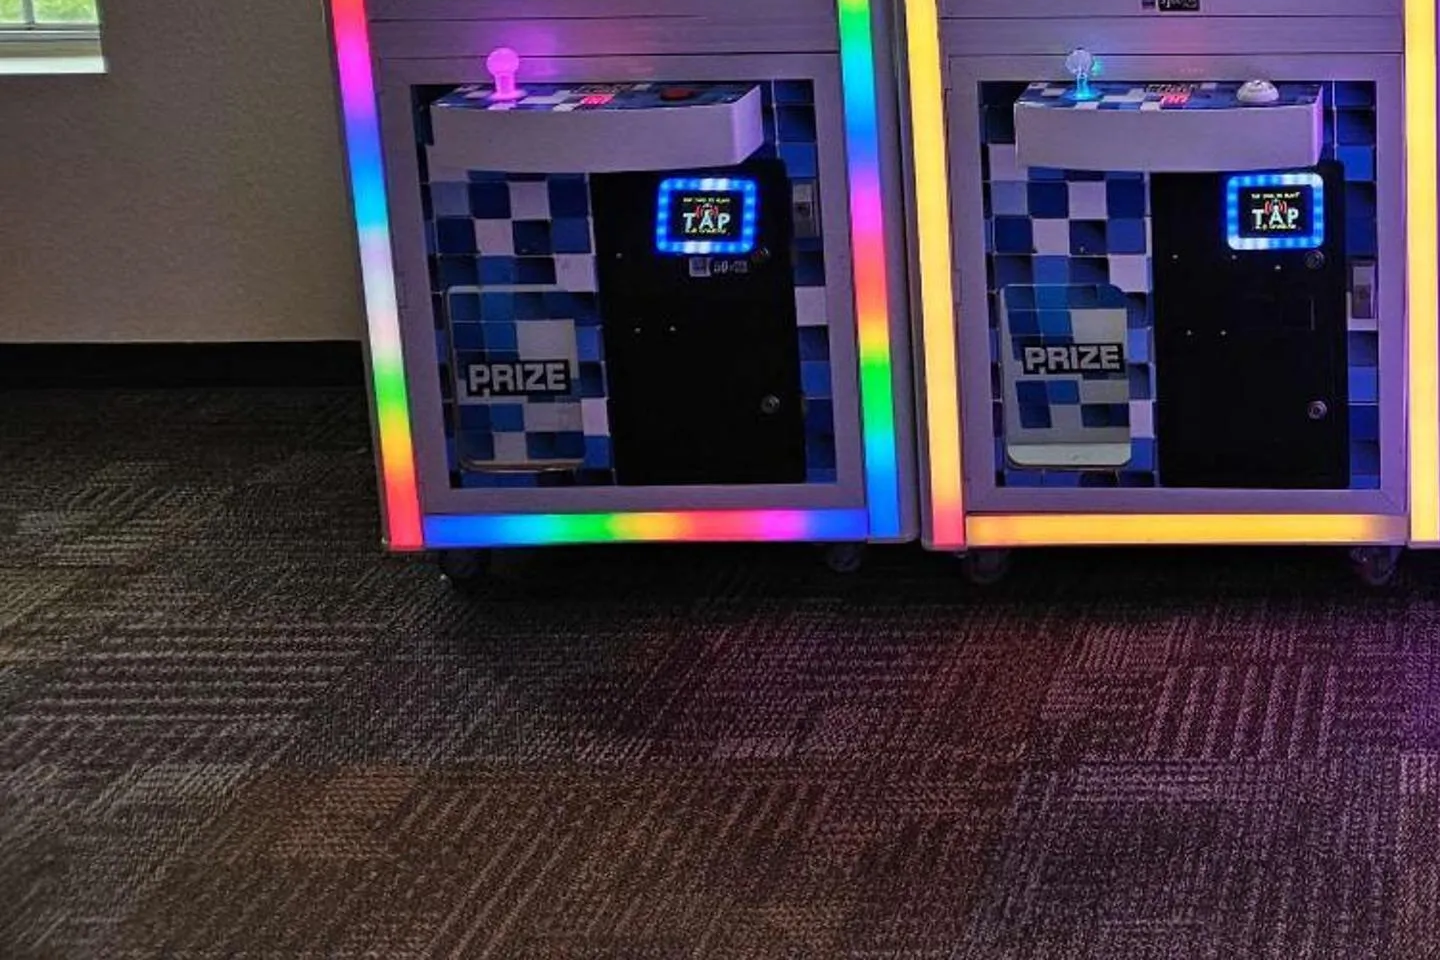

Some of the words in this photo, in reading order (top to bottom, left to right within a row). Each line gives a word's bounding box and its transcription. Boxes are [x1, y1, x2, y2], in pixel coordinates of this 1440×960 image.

[683, 209, 731, 233] TAP
[1251, 207, 1299, 229] TAP
[1024, 345, 1121, 371] PRIZE
[468, 362, 567, 393] PRIZE
